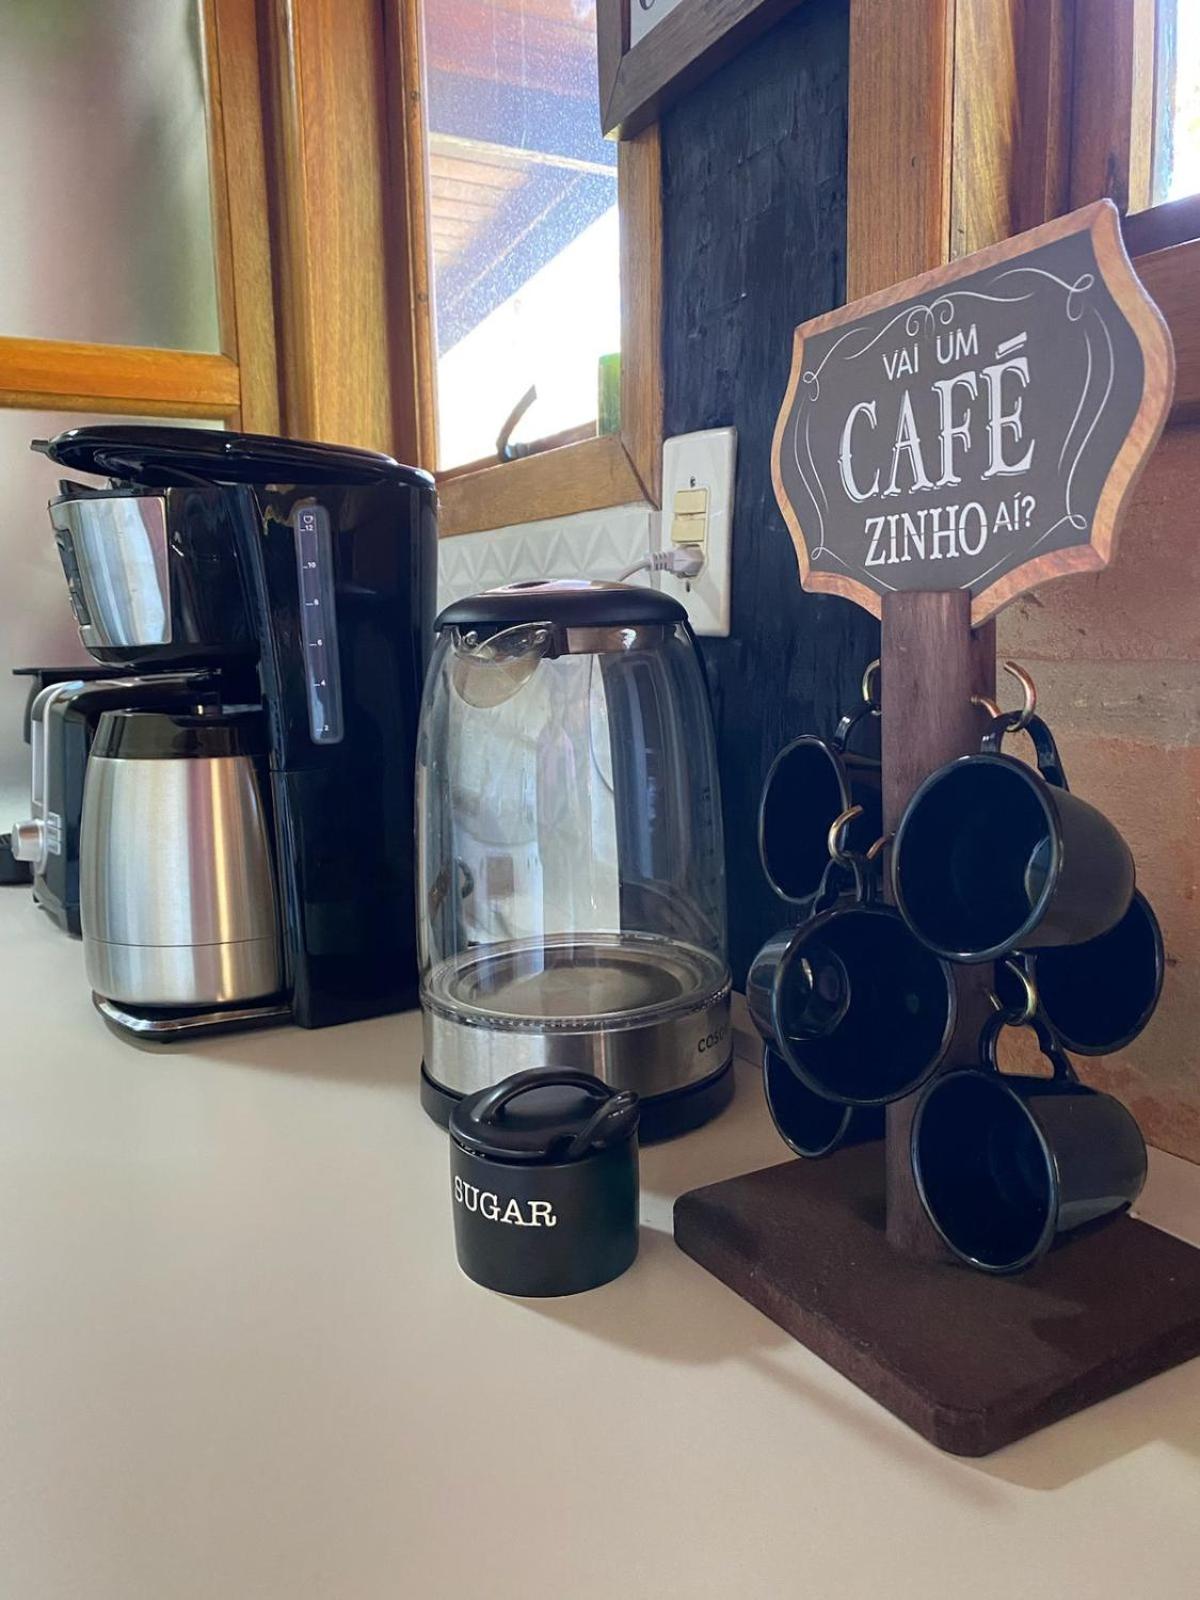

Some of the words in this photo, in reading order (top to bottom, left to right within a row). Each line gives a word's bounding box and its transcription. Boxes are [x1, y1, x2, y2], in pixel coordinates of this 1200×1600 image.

[882, 345, 919, 381] VAI
[935, 323, 978, 364] UM
[837, 332, 1035, 503] CAFÉ
[305, 524, 314, 532] 12
[864, 502, 988, 566] ZINHO
[992, 491, 1036, 533] AÍ?
[307, 561, 316, 569] 10
[454, 1175, 557, 1227] SUGAR
